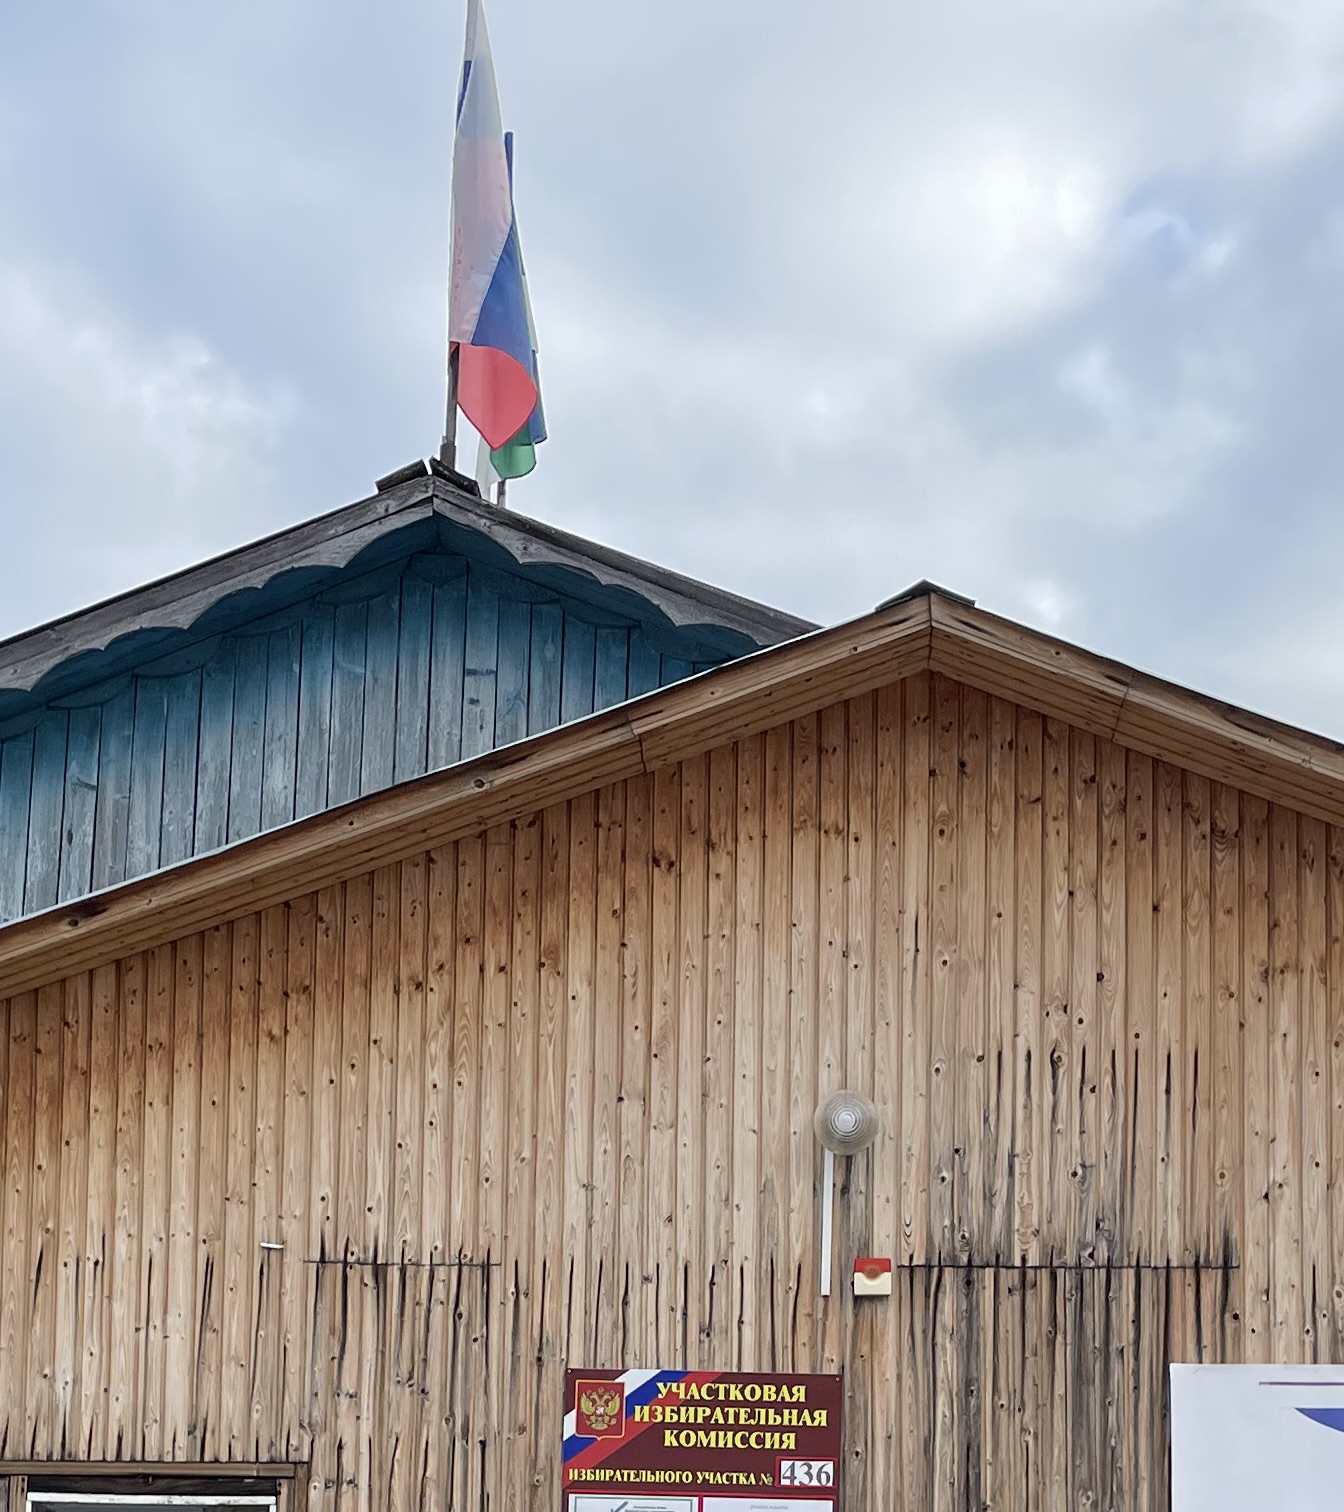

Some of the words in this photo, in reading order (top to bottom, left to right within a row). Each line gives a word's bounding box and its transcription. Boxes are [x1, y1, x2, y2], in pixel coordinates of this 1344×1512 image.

[656, 1382, 807, 1403] УЧАСТКОВАЯ
[634, 1405, 828, 1427] ИЗБИРАТЕЛЬНАЯ
[663, 1429, 797, 1450] КОМИССИЯ
[568, 1468, 693, 1484] ИЗБИРАТЕЛЬНОГО
[696, 1471, 756, 1486] УЧАСТКА
[782, 1461, 832, 1486] 436
